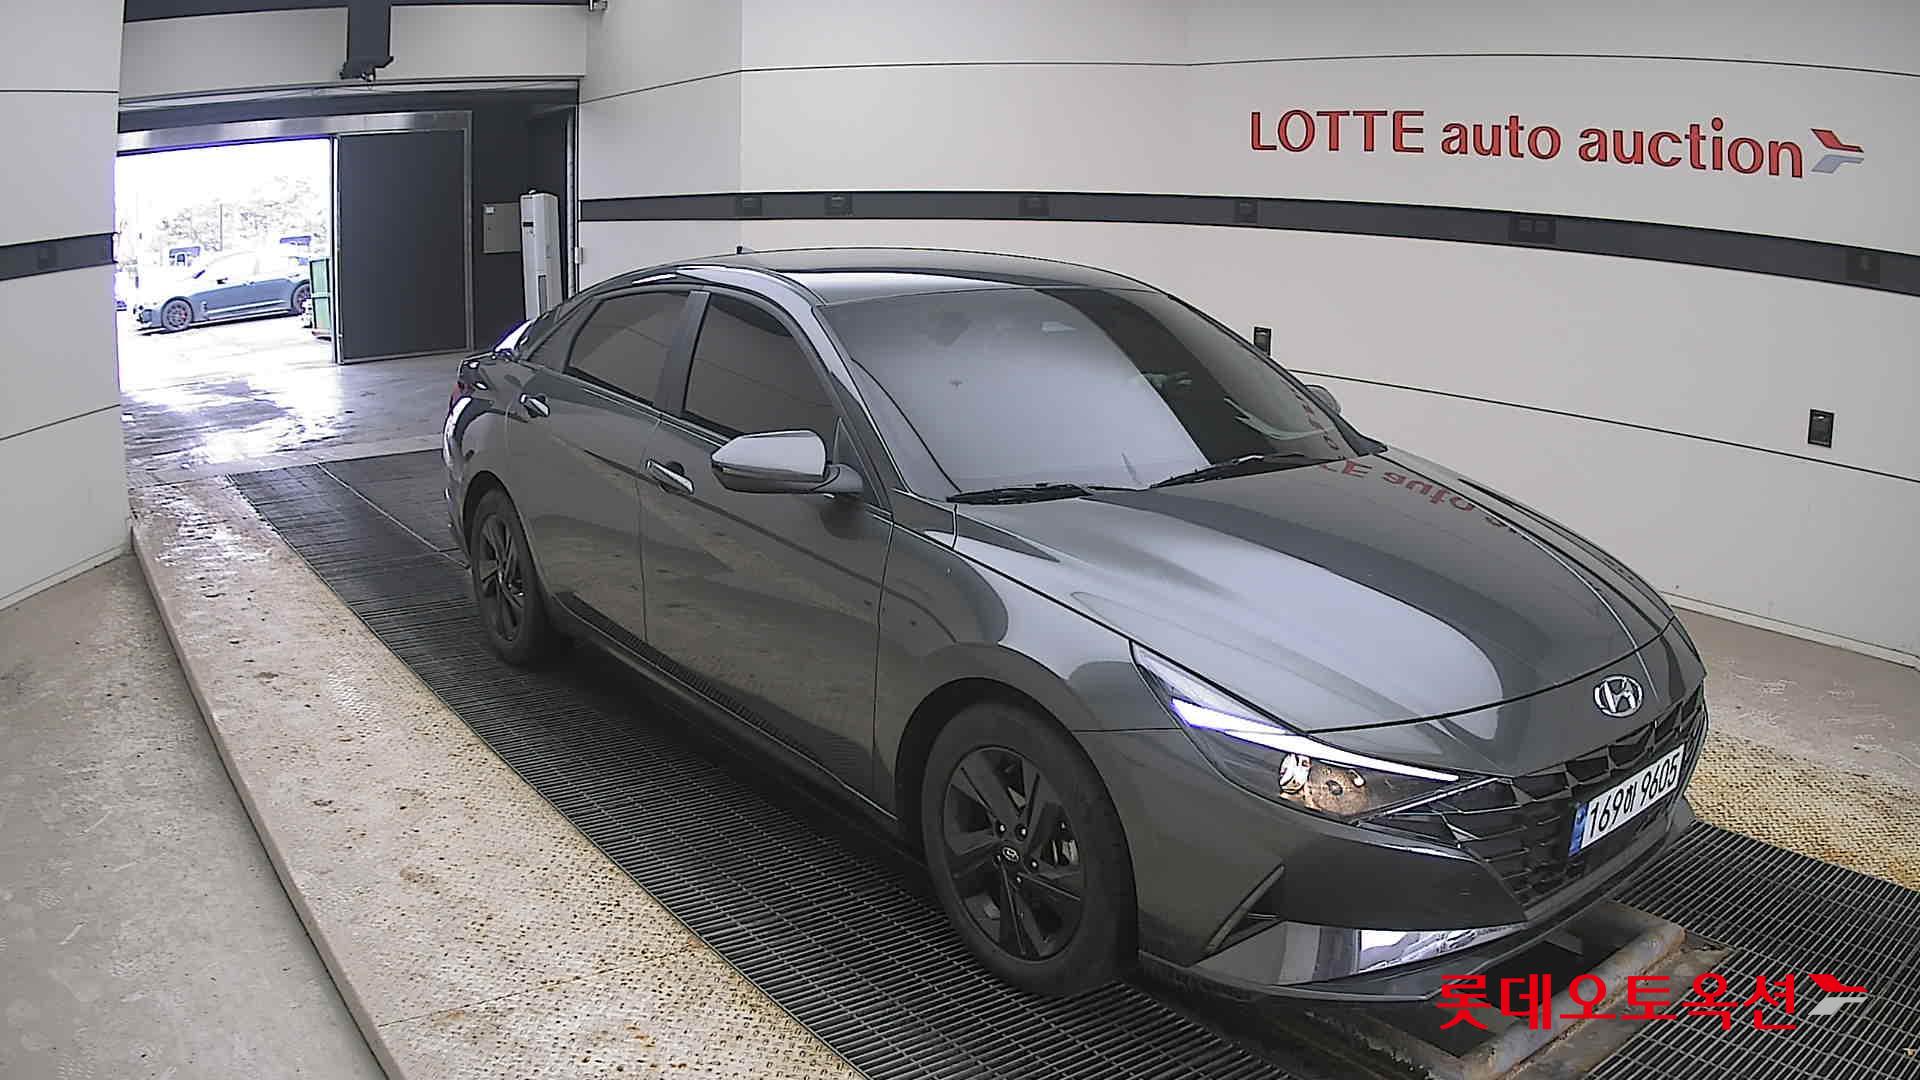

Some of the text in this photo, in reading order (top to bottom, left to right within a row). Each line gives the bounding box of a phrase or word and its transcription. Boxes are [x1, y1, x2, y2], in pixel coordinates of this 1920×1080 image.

[1251, 109, 1803, 178] LOTTE auto auction
[1641, 752, 1680, 806] 9605
